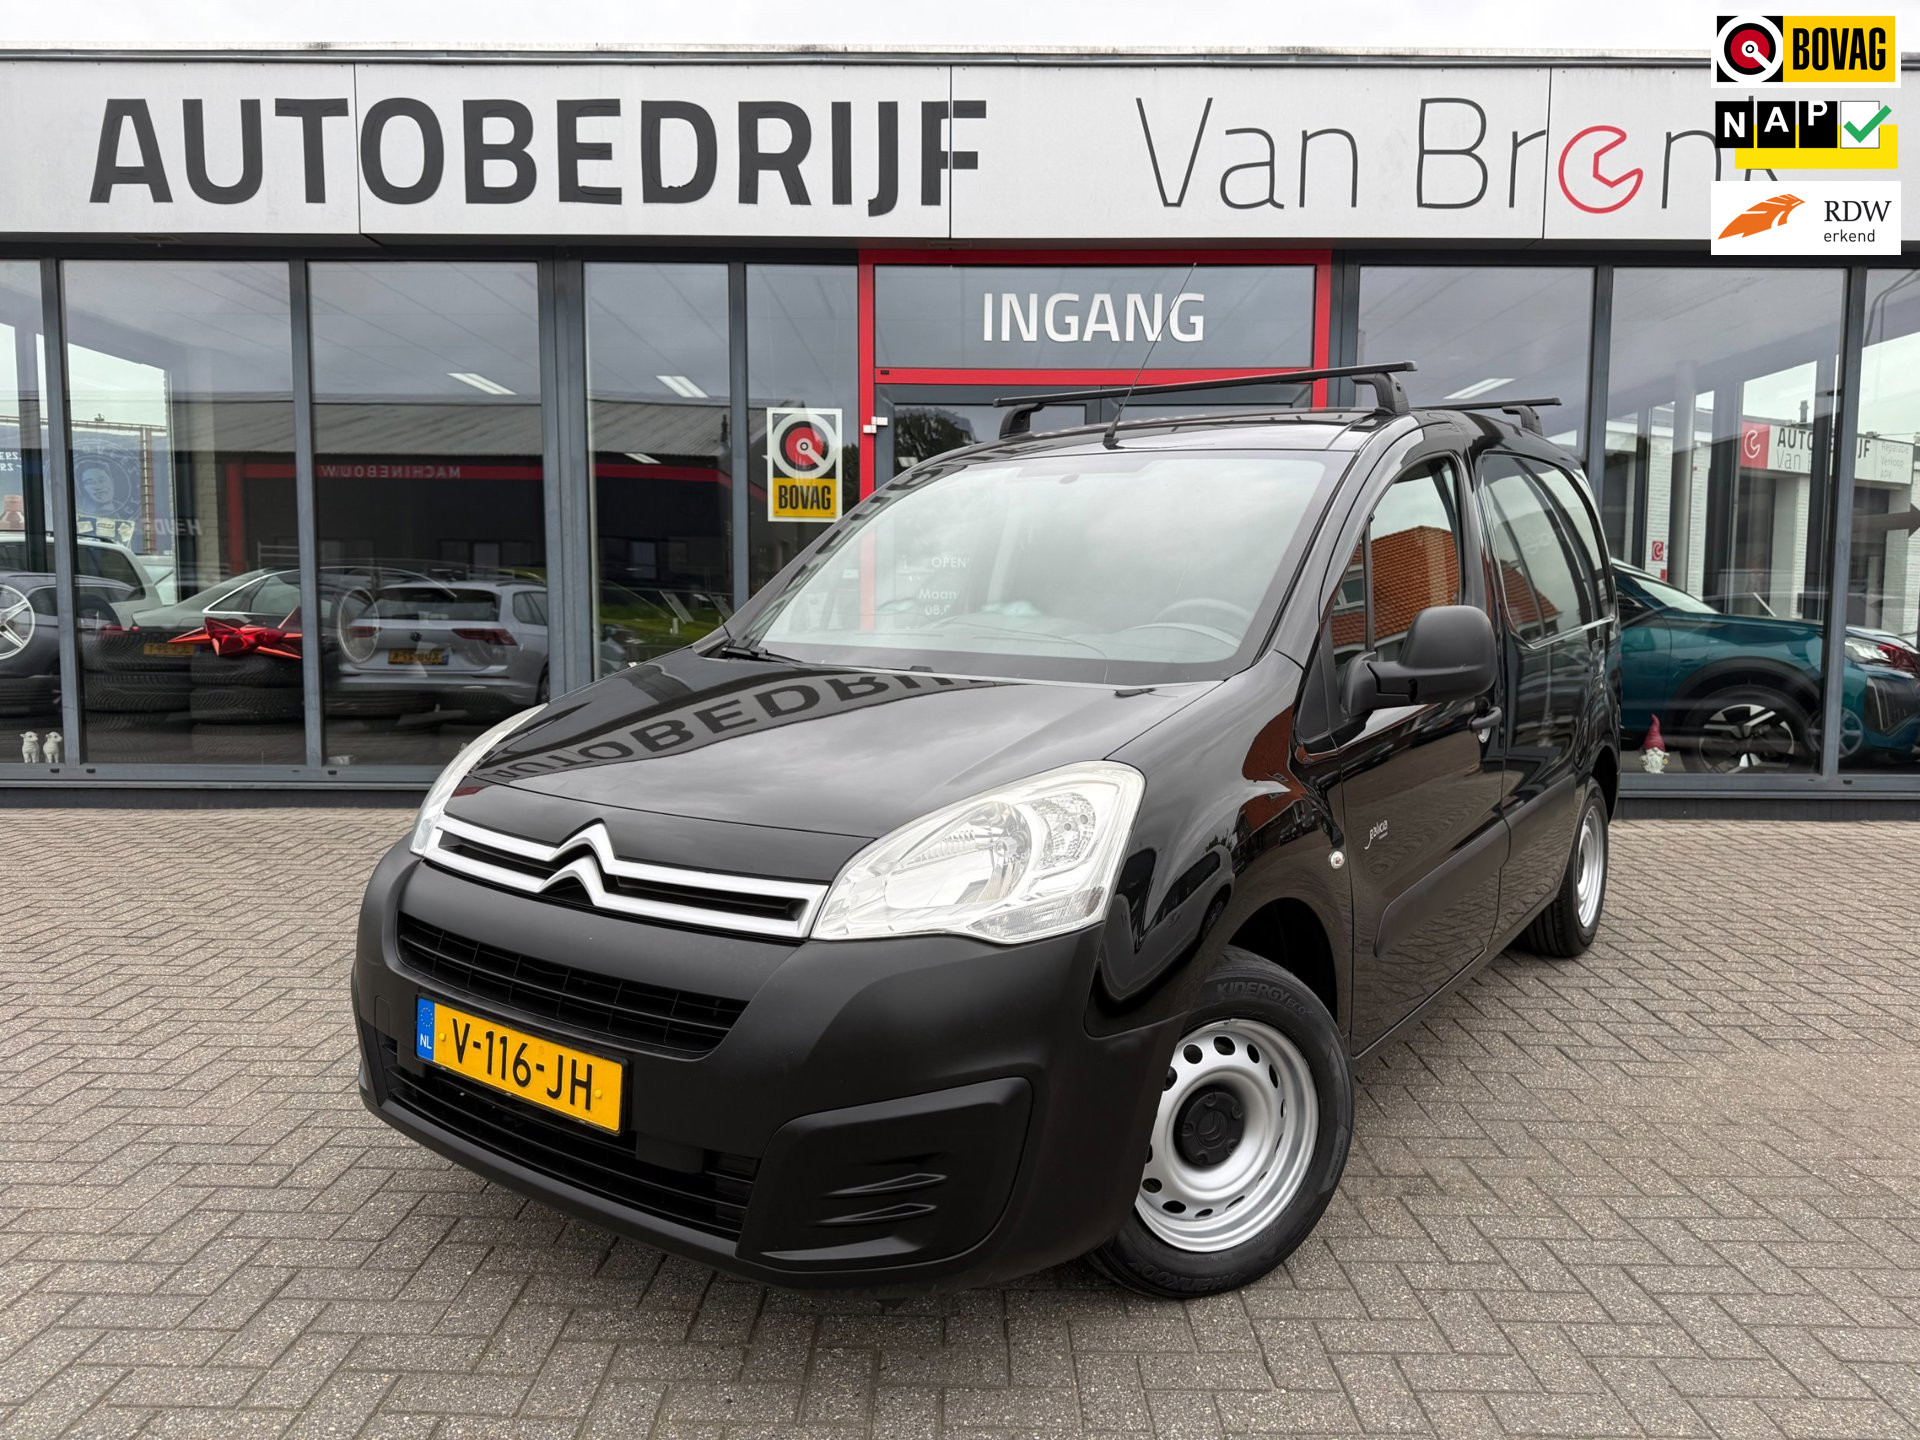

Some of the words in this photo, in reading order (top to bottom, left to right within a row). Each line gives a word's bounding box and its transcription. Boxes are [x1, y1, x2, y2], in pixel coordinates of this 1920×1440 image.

[89, 97, 987, 217] AUTOBEDRIJF
[1135, 97, 1358, 210] Van
[1416, 95, 1779, 214] Bren
[983, 292, 1205, 343] INGANG
[778, 484, 832, 511] BOVAG
[419, 1033, 432, 1050] NL
[452, 1018, 593, 1111] V-116-JH
